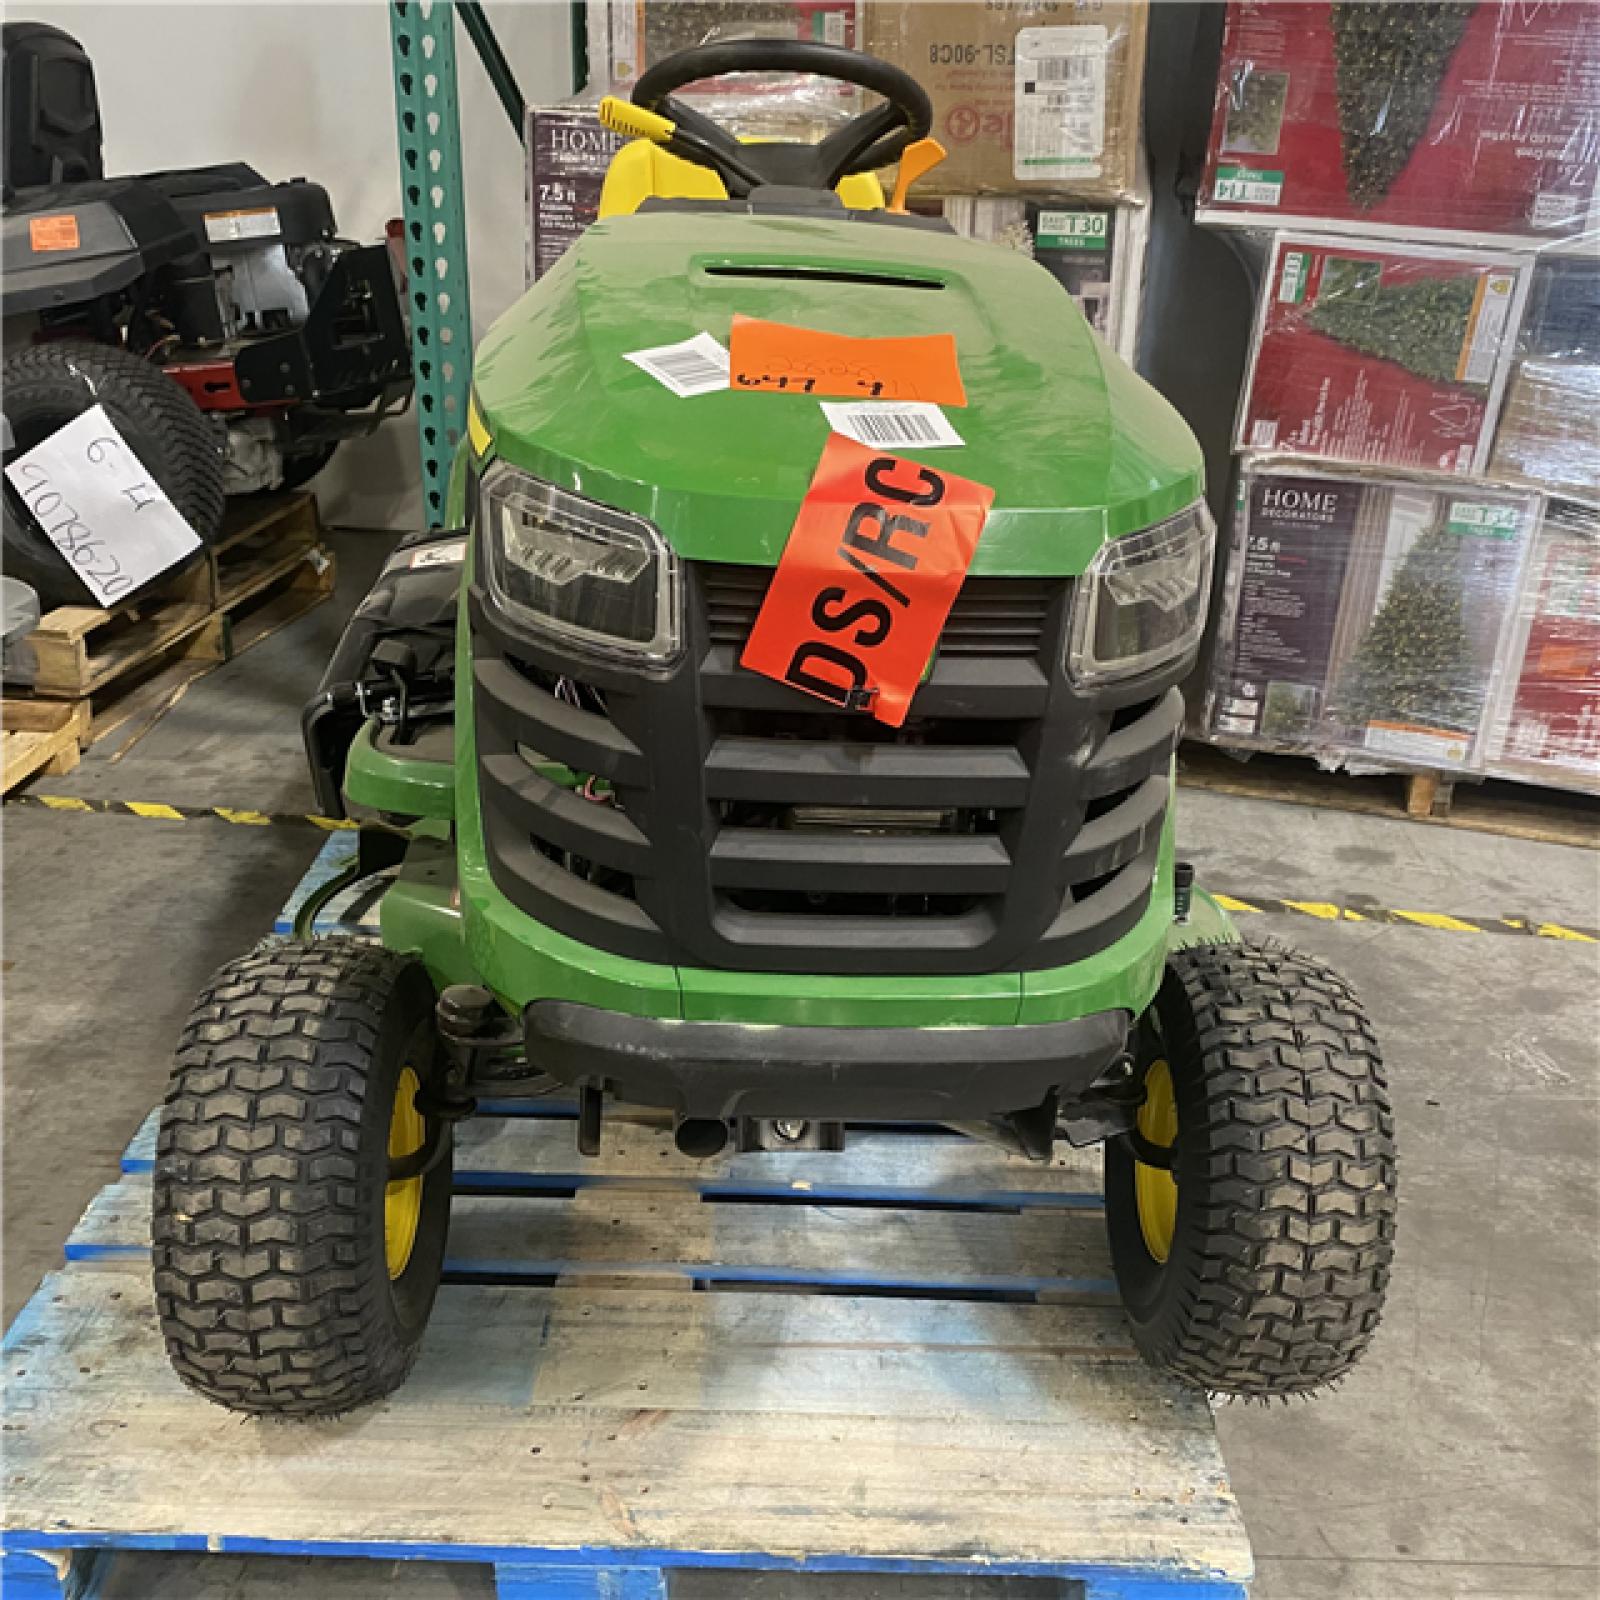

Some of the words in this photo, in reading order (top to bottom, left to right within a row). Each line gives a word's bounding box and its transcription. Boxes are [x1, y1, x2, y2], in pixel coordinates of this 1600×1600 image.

[551, 129, 621, 153] HOME
[1065, 214, 1104, 234] T30
[1262, 488, 1338, 513] HOME
[784, 457, 946, 705] DS/RC
